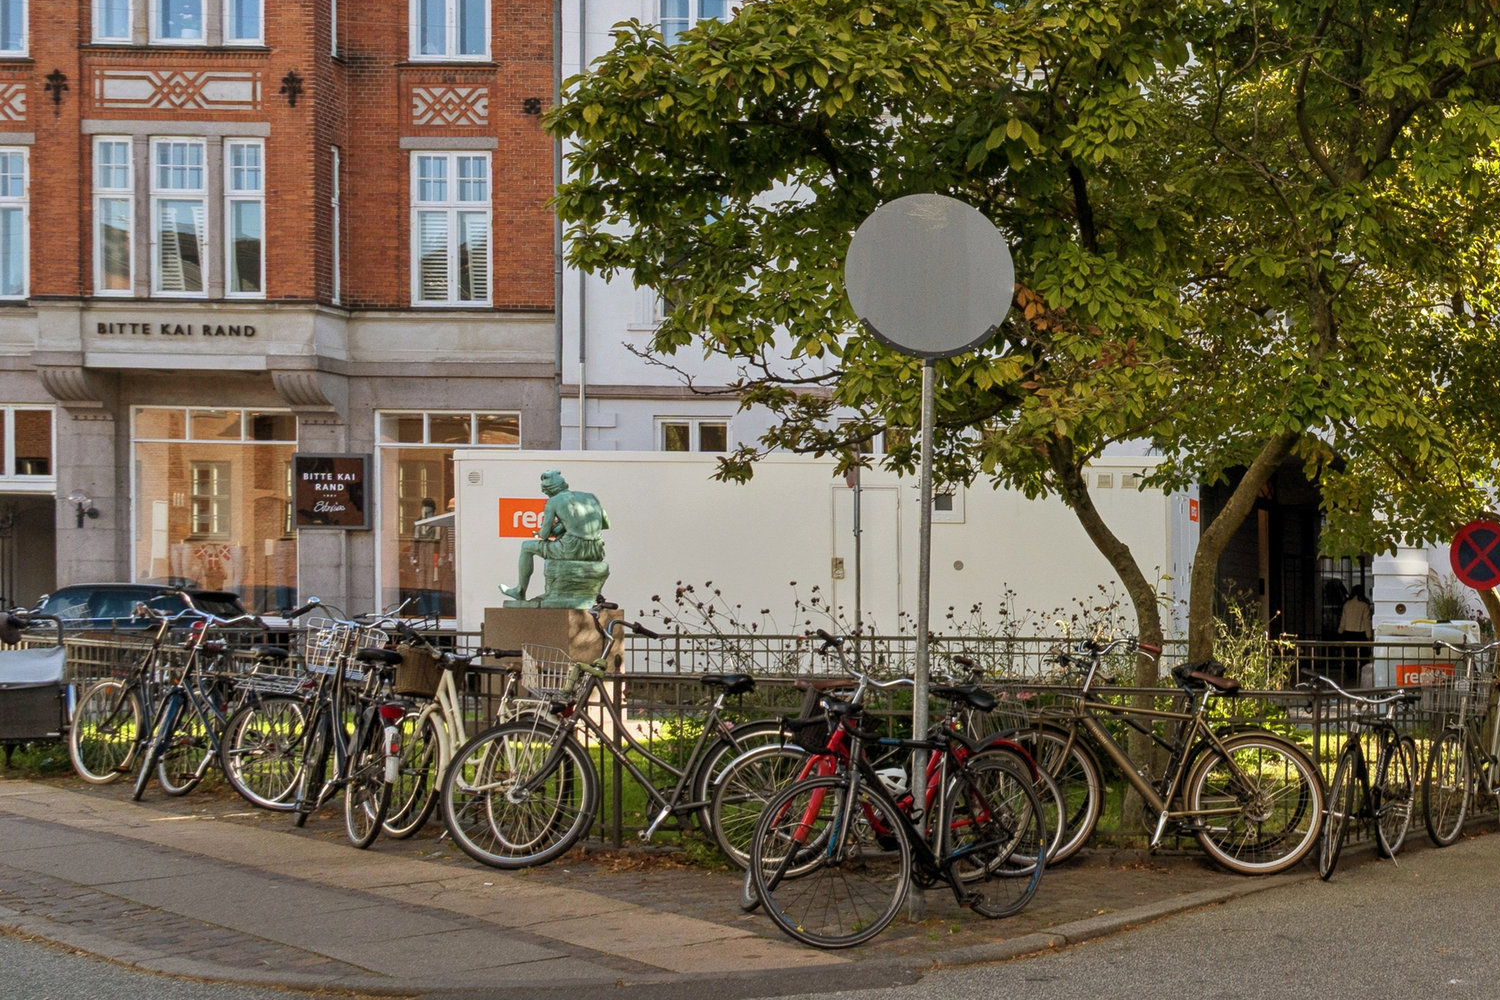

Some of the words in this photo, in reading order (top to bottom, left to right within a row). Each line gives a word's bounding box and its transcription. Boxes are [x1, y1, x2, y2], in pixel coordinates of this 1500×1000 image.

[97, 323, 150, 335] BITTE
[160, 324, 192, 336] KAI
[202, 325, 256, 337] RAND
[303, 473, 333, 481] BITTE
[337, 473, 356, 481] KAI
[315, 483, 345, 491] RAND
